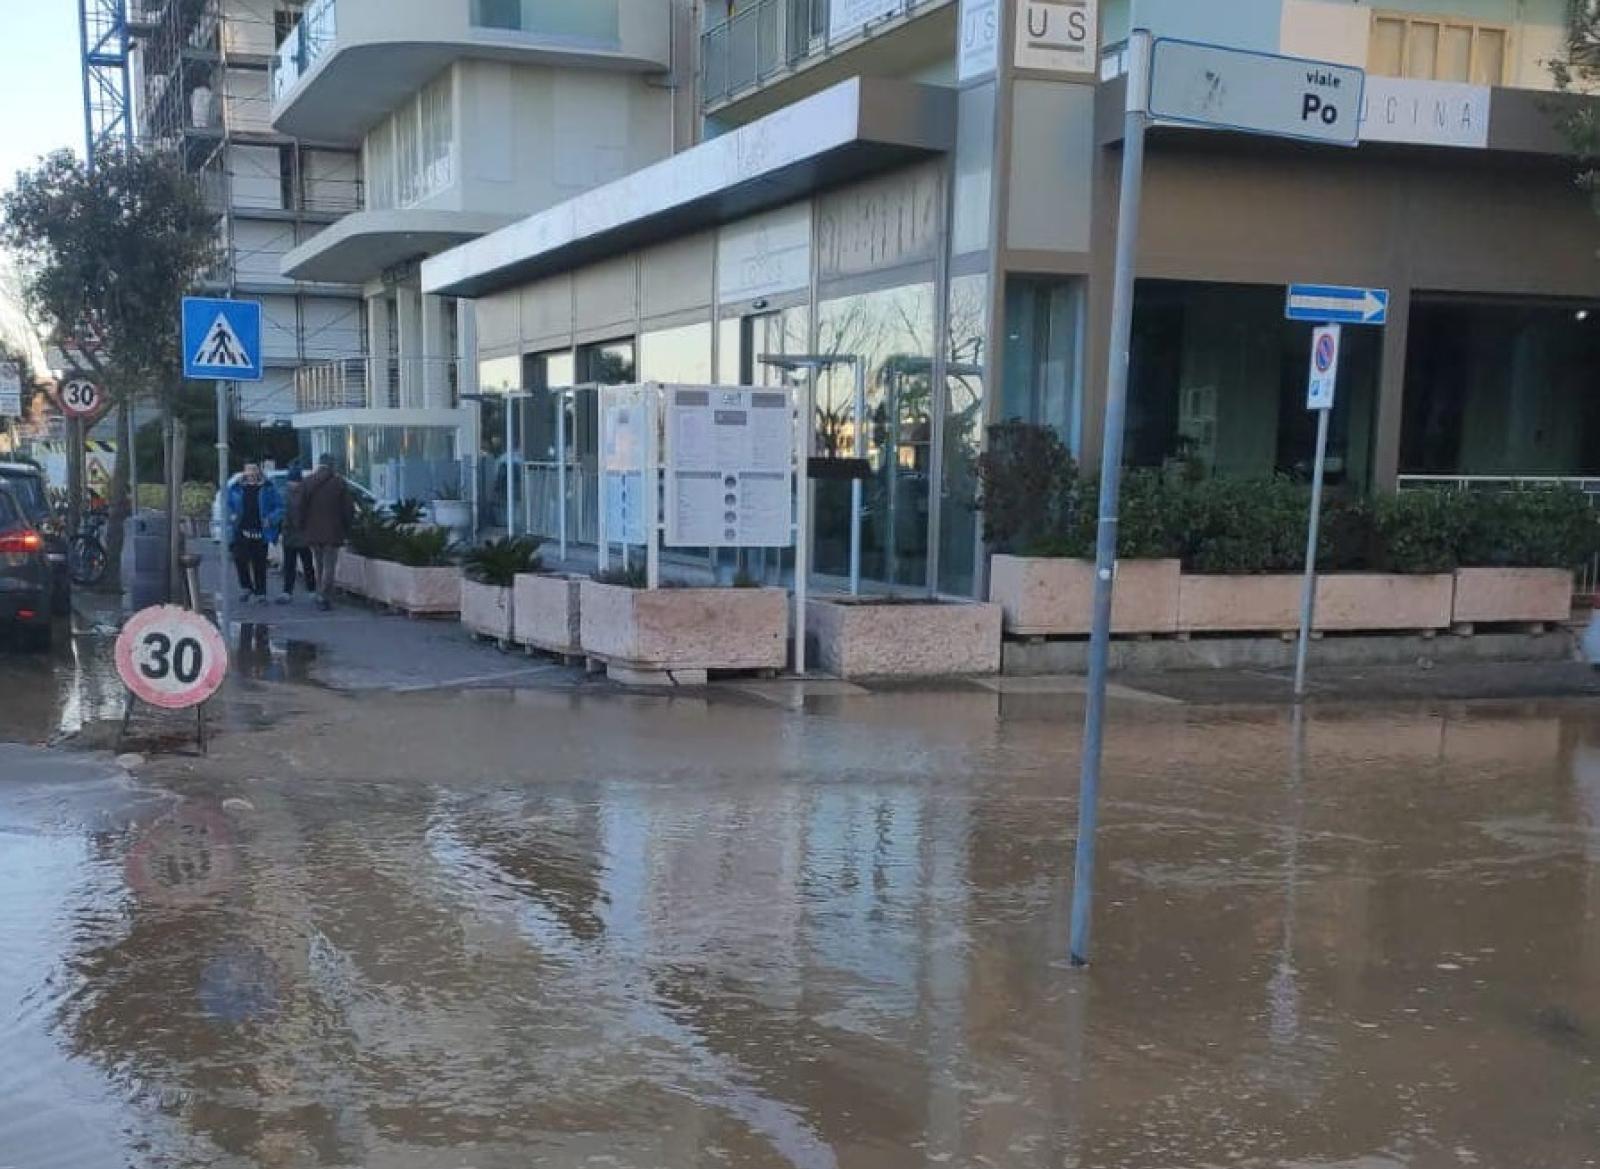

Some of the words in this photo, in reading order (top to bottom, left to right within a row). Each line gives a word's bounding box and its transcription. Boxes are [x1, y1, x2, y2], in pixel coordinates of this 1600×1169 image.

[1028, 8, 1086, 42] US
[1306, 69, 1341, 88] viale
[1302, 93, 1338, 124] Po
[68, 383, 94, 406] 30
[140, 631, 203, 684] 30
